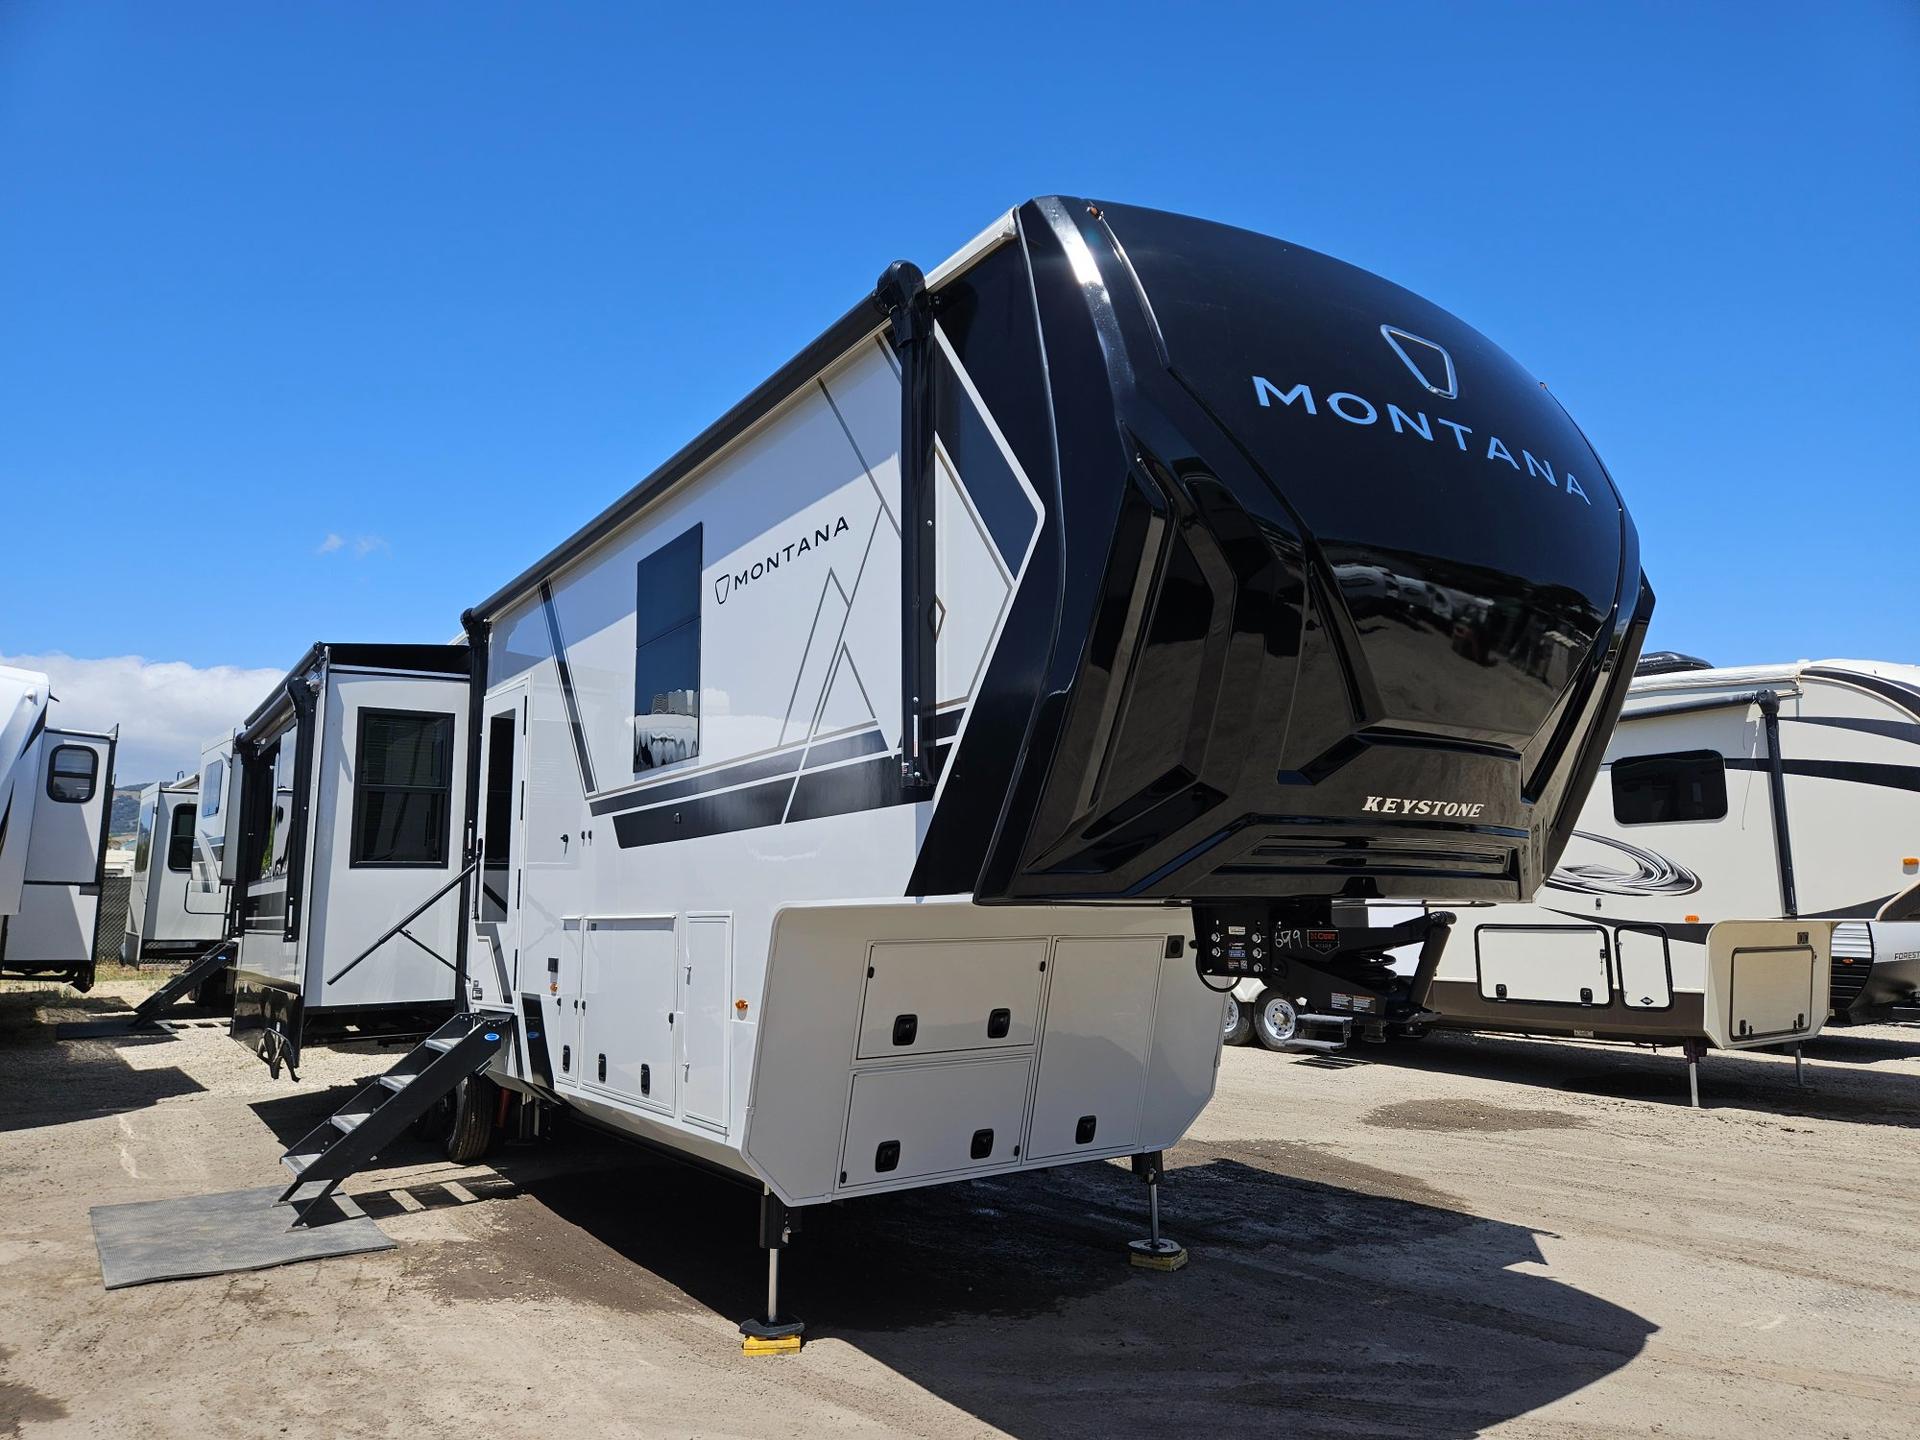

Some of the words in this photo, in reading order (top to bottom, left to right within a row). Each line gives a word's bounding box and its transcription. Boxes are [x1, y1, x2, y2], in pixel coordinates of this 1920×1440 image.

[1252, 375, 1592, 505] MONTANA
[734, 516, 849, 590] MONTANA
[1362, 796, 1484, 817] KEYSTONE
